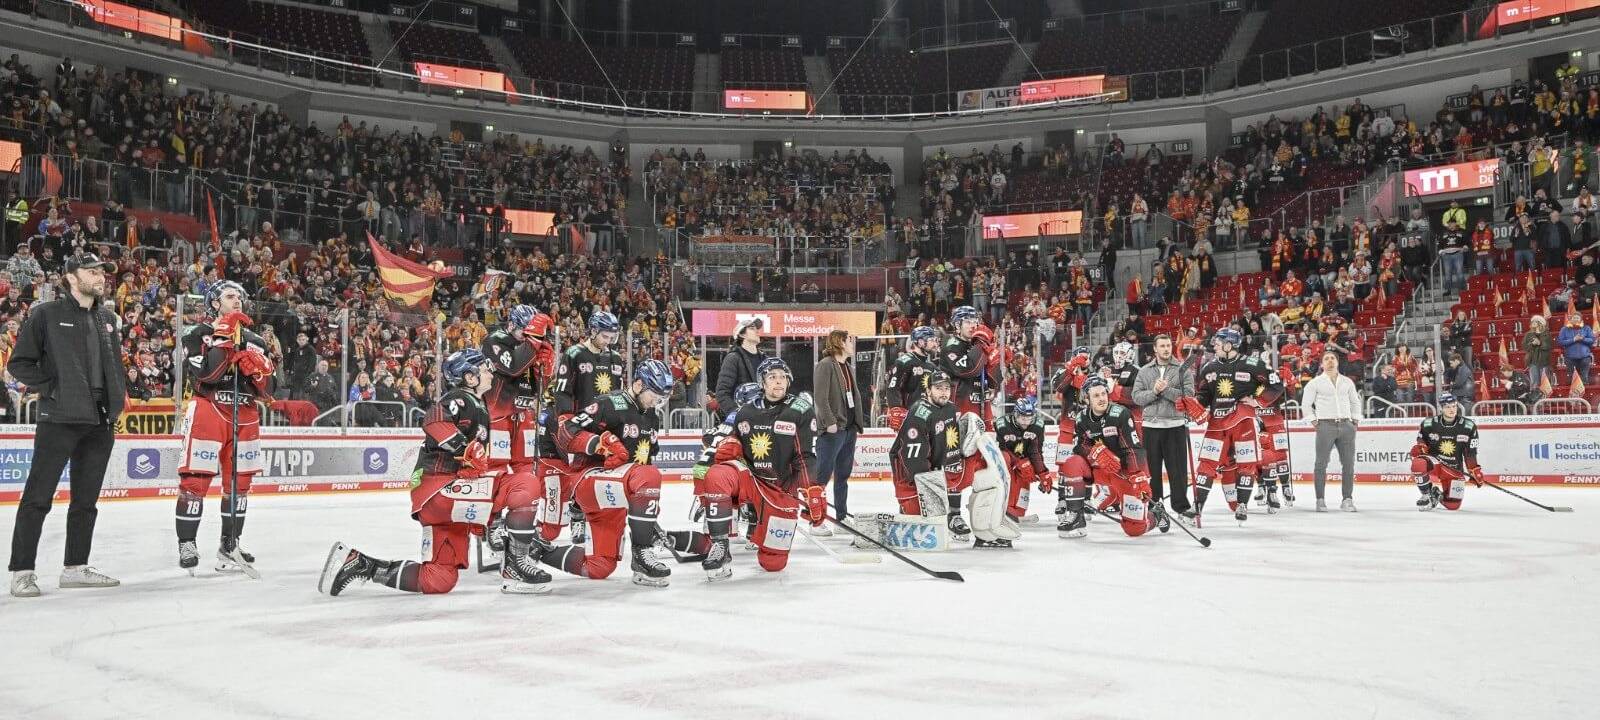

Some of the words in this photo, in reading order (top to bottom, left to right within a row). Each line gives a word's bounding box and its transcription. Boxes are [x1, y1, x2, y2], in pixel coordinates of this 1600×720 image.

[784, 314, 815, 323] Messe
[784, 325, 834, 334] Düsseldorf
[1555, 442, 1600, 450] Deutsch
[907, 443, 921, 458] 77
[1357, 452, 1412, 463] EINMETA
[1555, 452, 1600, 460] Hochsch
[1499, 475, 1535, 483] PENNY.
[1564, 476, 1600, 484] PENNY
[278, 484, 309, 492] PENNY.
[331, 483, 361, 491] PENNY.
[100, 489, 129, 497] ENNY.
[158, 488, 179, 496] PEN
[186, 501, 200, 514] 18
[236, 498, 247, 512] 18
[710, 503, 718, 516] 5
[877, 513, 895, 521] CCM
[769, 529, 793, 539] +GF+
